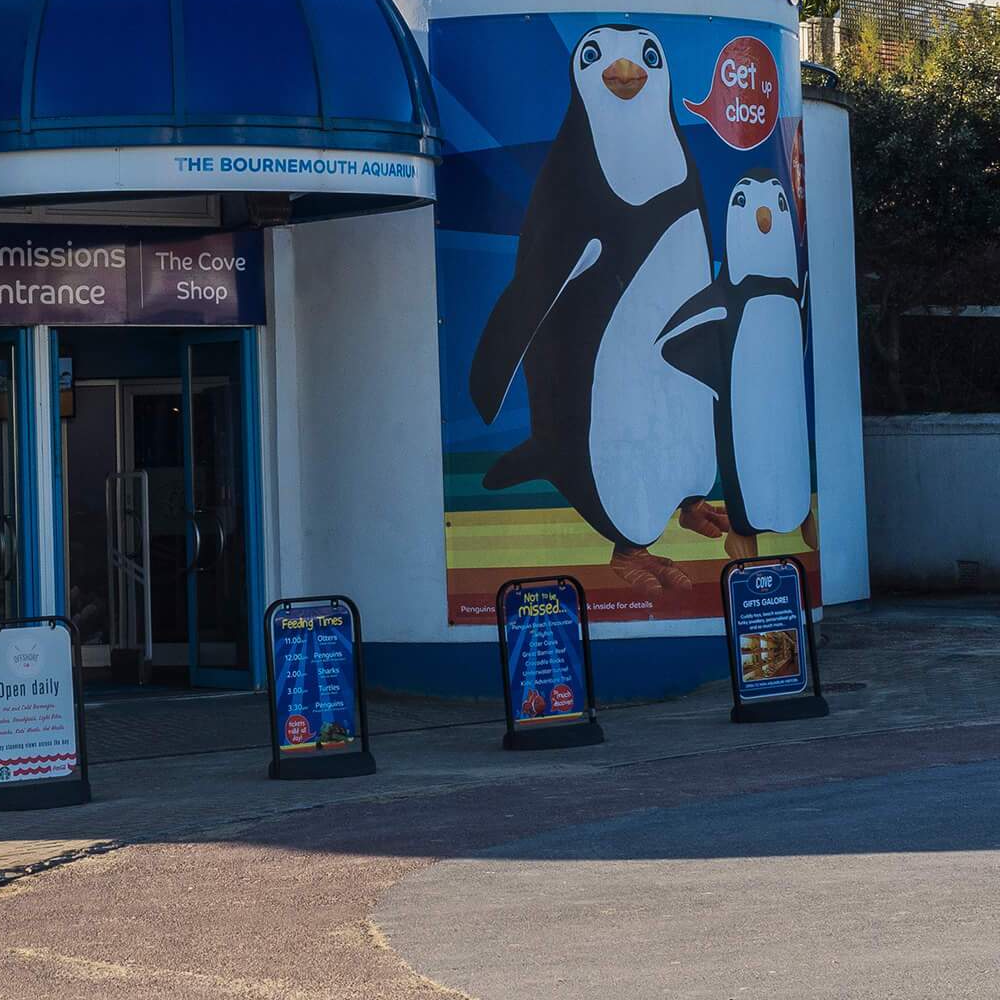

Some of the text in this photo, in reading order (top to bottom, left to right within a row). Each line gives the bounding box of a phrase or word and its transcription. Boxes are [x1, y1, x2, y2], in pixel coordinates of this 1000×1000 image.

[721, 58, 773, 99] Get up
[725, 97, 766, 125] close
[174, 157, 214, 172] THE
[220, 157, 357, 175] BOURNEMOUTH
[155, 251, 247, 272] The Cove
[176, 280, 229, 304] Shop
[524, 592, 539, 604] Not
[593, 602, 616, 611] inside
[616, 602, 628, 610] for
[628, 600, 654, 610] details
[743, 599, 761, 609] GIFTS
[460, 605, 497, 615] Penguins
[281, 615, 344, 631] Feeding Times
[31, 678, 60, 697] daily
